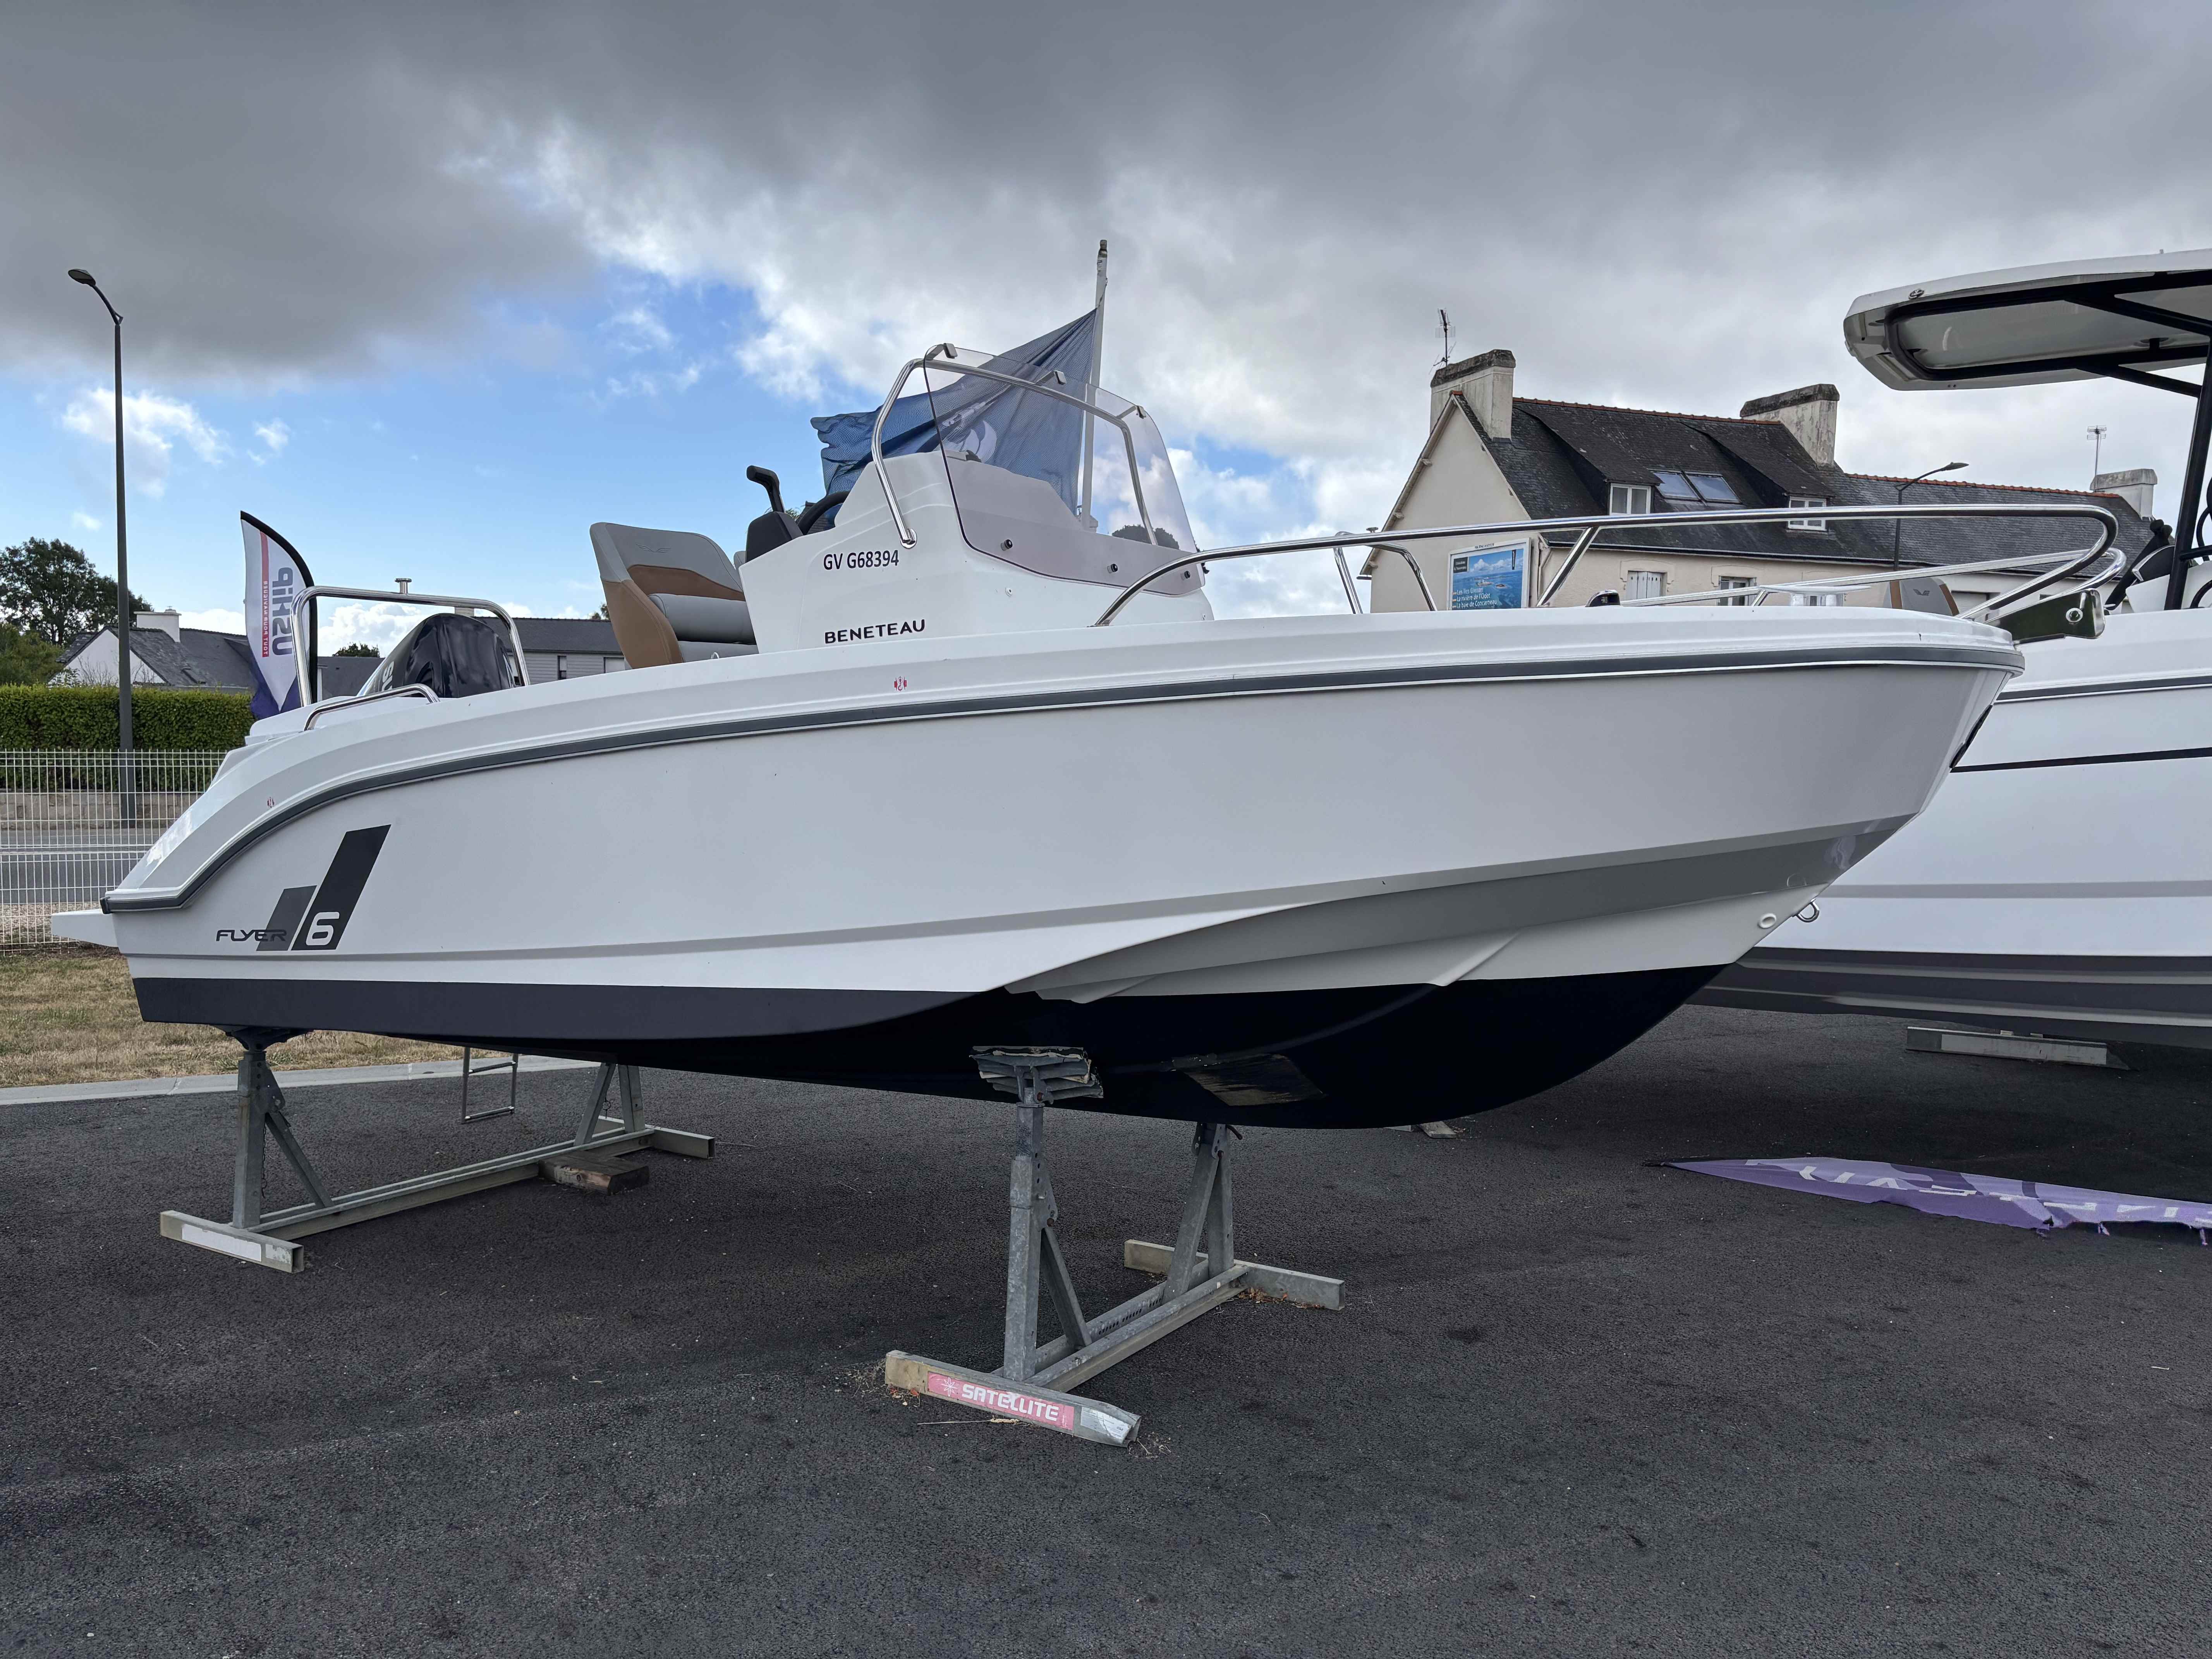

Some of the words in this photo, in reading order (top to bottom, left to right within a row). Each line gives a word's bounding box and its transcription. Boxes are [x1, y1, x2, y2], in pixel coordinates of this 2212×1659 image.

[823, 553, 843, 570] GV
[847, 550, 899, 569] G68394
[824, 619, 925, 644] BENETEAU
[216, 929, 287, 942] FLYER
[305, 911, 340, 946] 6
[962, 1384, 1060, 1421] SATELLITE
